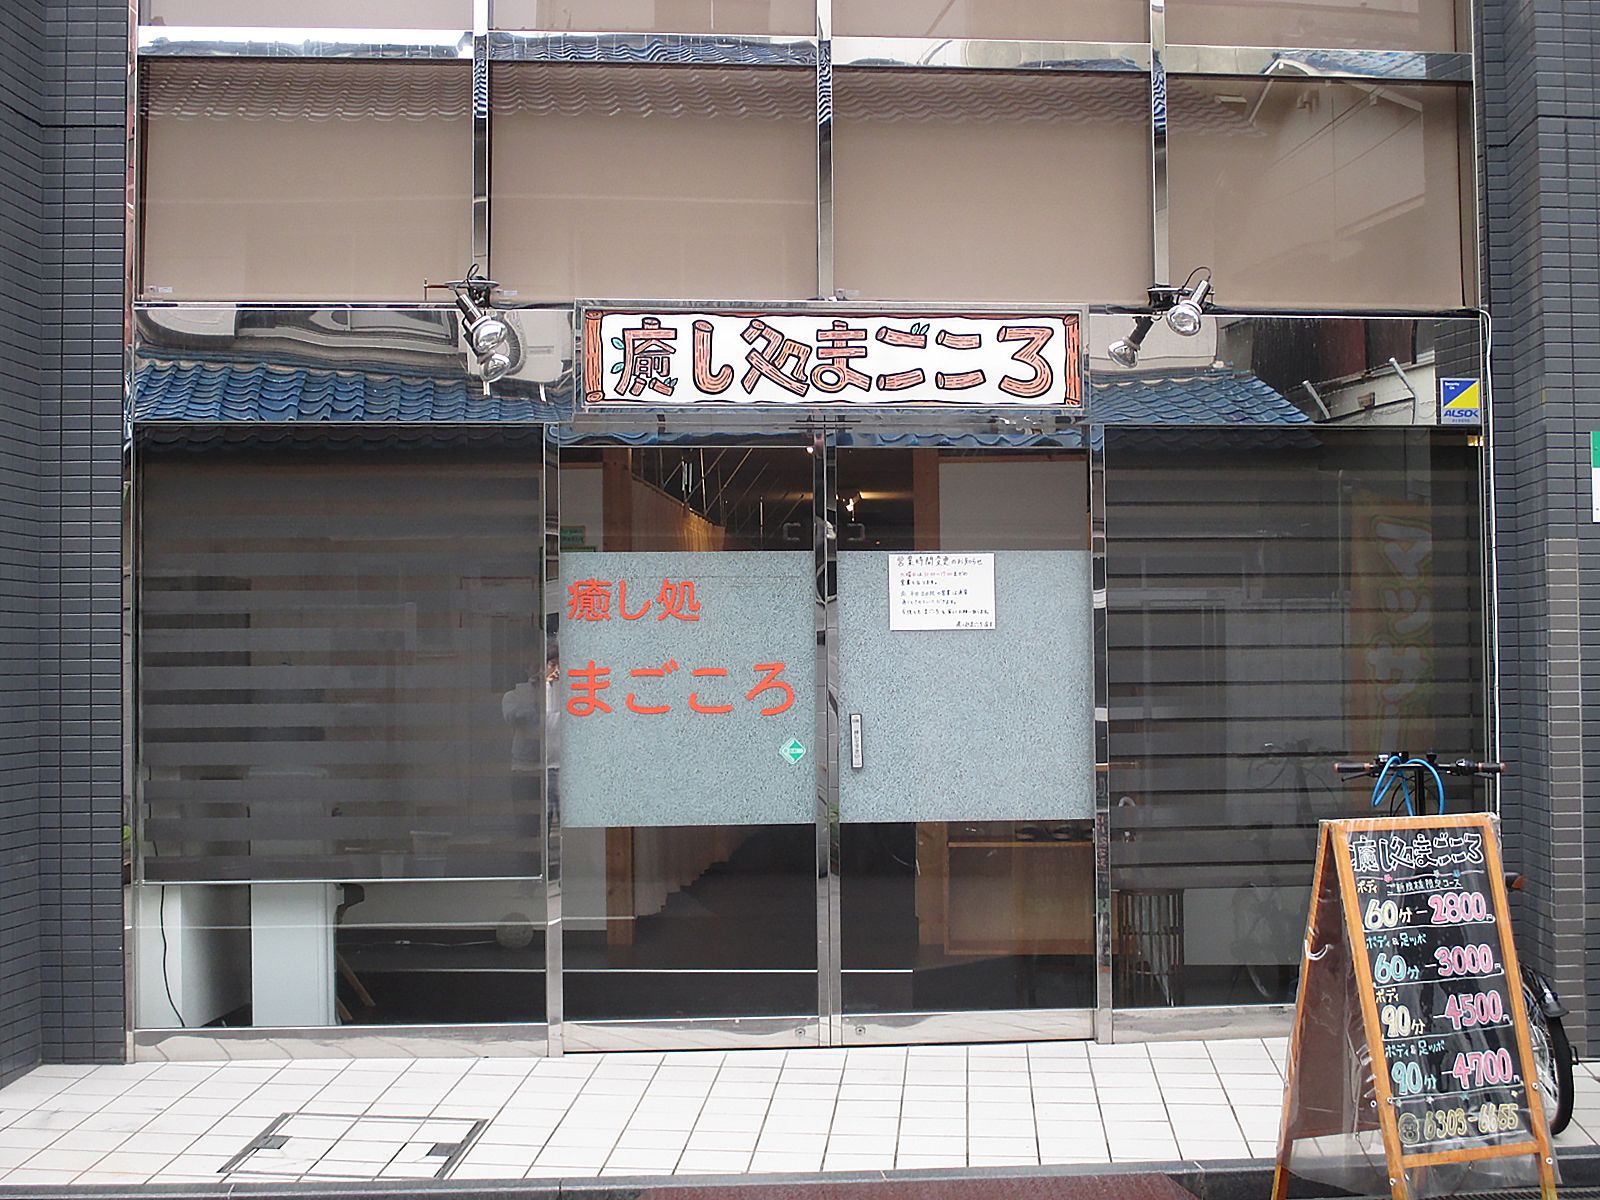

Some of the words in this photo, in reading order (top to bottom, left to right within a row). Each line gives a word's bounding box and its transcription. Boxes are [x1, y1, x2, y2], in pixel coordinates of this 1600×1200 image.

[610, 318, 1054, 398] 癒し処まごころ
[1444, 409, 1478, 417] ALSOK
[567, 577, 701, 621] 癒し処
[566, 659, 795, 716] まごころ
[1348, 833, 1484, 873] 癒し処まごころ
[1424, 1102, 1519, 1140] 6303-6655
